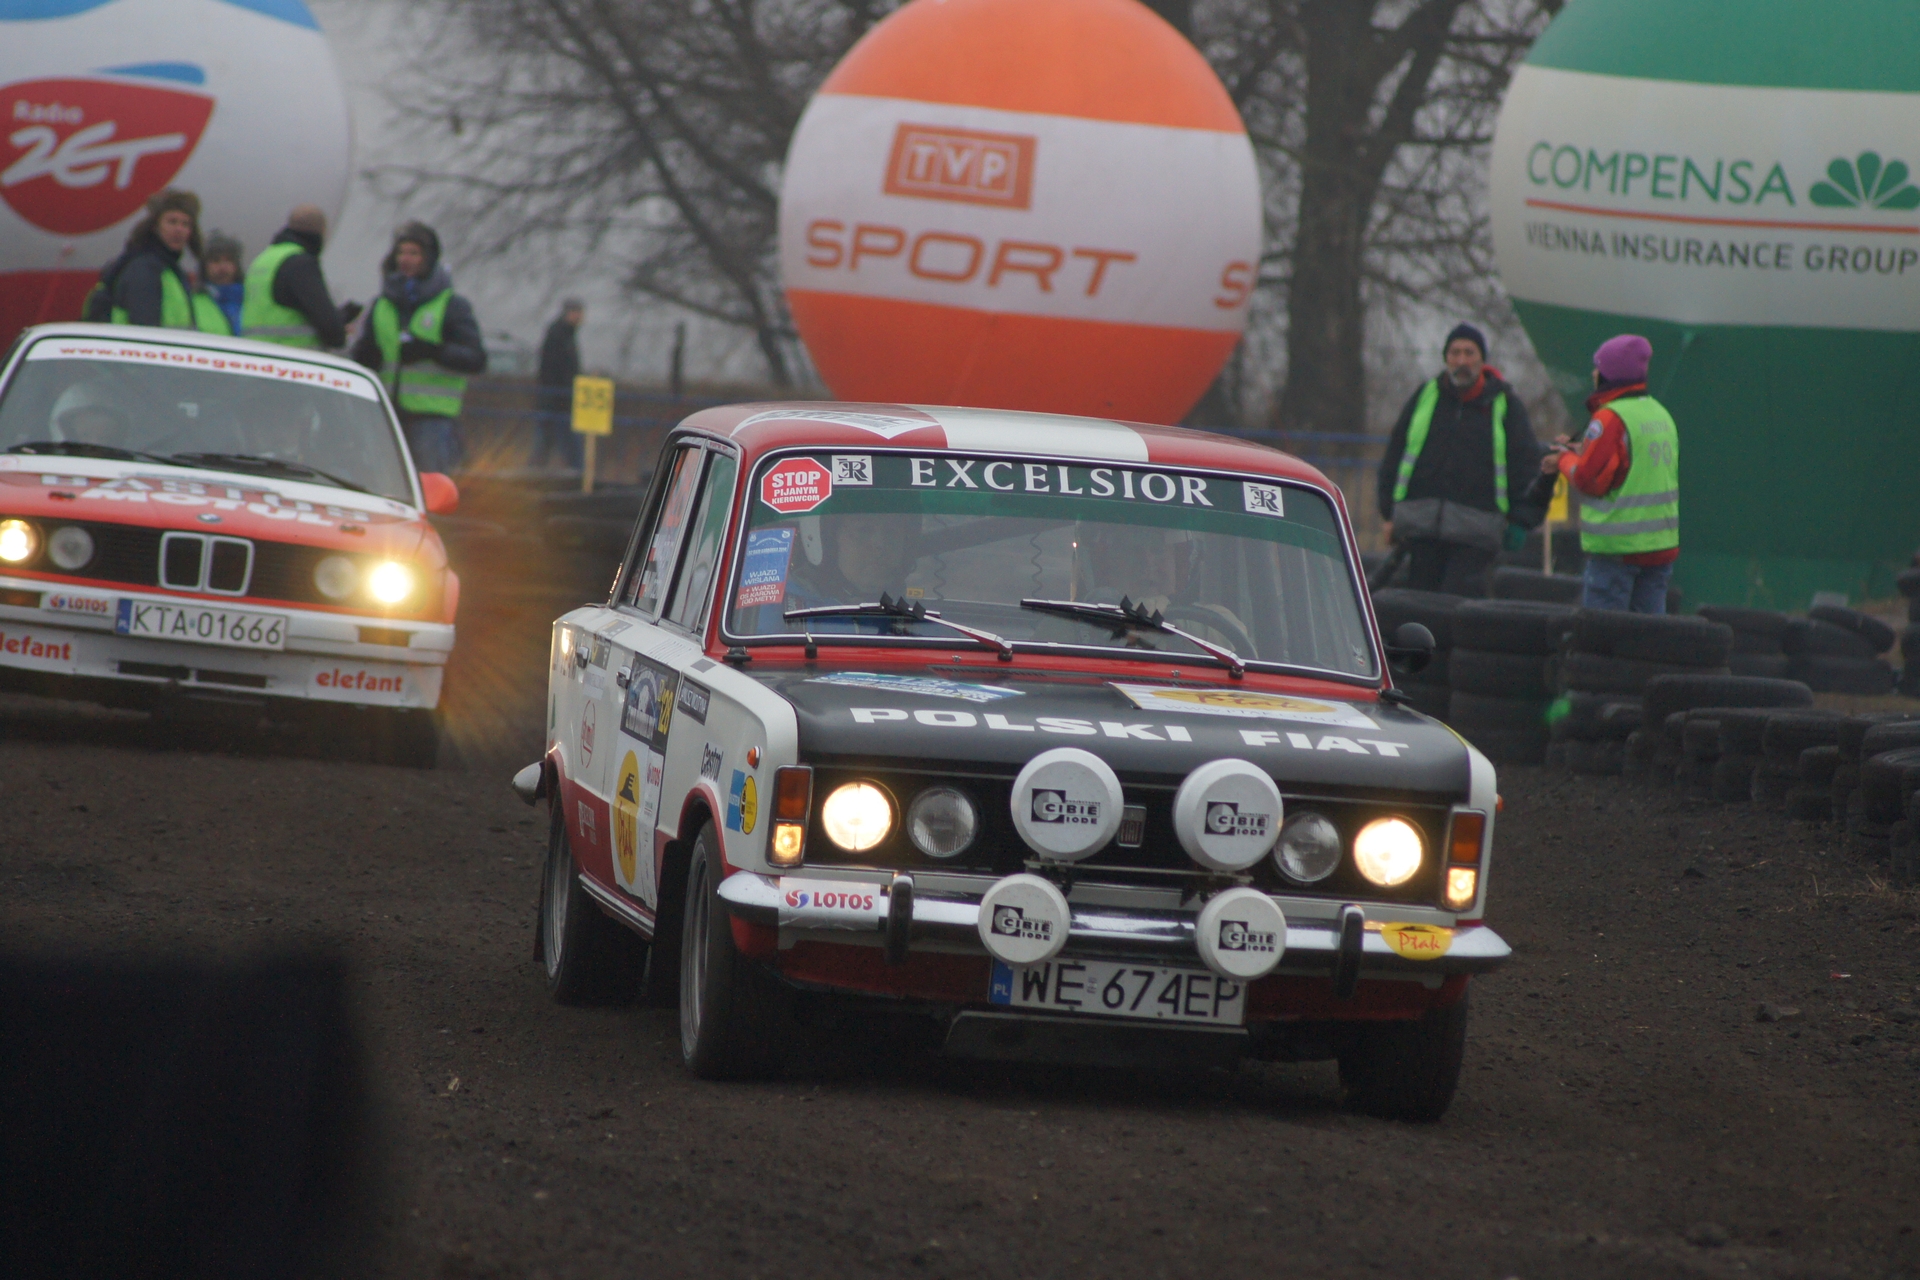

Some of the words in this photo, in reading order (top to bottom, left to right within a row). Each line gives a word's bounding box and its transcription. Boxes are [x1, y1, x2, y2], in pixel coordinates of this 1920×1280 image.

[14, 100, 83, 125] Radio
[908, 141, 1007, 187] TVP
[1526, 141, 1796, 207] COMPENSA
[806, 218, 1137, 298] SPORT
[1526, 221, 1605, 255] VIENNA
[1611, 233, 1794, 271] INSURANCE
[1804, 243, 1919, 275] GROUP
[1648, 440, 1672, 468] 90
[772, 471, 821, 488] STOP
[910, 457, 1213, 507] EXCELSIOR
[771, 495, 820, 505] KIEROWCOM
[774, 486, 818, 497] PIJANYM
[81, 487, 334, 526] MOTUL
[749, 569, 778, 578] WJAZD
[750, 589, 780, 598] KAROWA
[751, 584, 776, 592] WJAZD
[68, 597, 107, 613] LOTOS
[133, 604, 188, 636] KTA
[197, 611, 283, 646] 01666
[316, 668, 403, 693] elefant
[850, 707, 1193, 743] POLSKI
[1239, 729, 1410, 758] FIAT
[1066, 816, 1098, 825] IODE
[1236, 828, 1266, 837] IODE
[813, 891, 874, 911] LOTOS
[1022, 931, 1051, 942] IODE
[1399, 931, 1441, 951] Ptak
[1247, 944, 1275, 953] IODE
[993, 983, 1009, 996] PL
[1021, 962, 1087, 1006] WE
[1102, 968, 1241, 1019] 674EP
